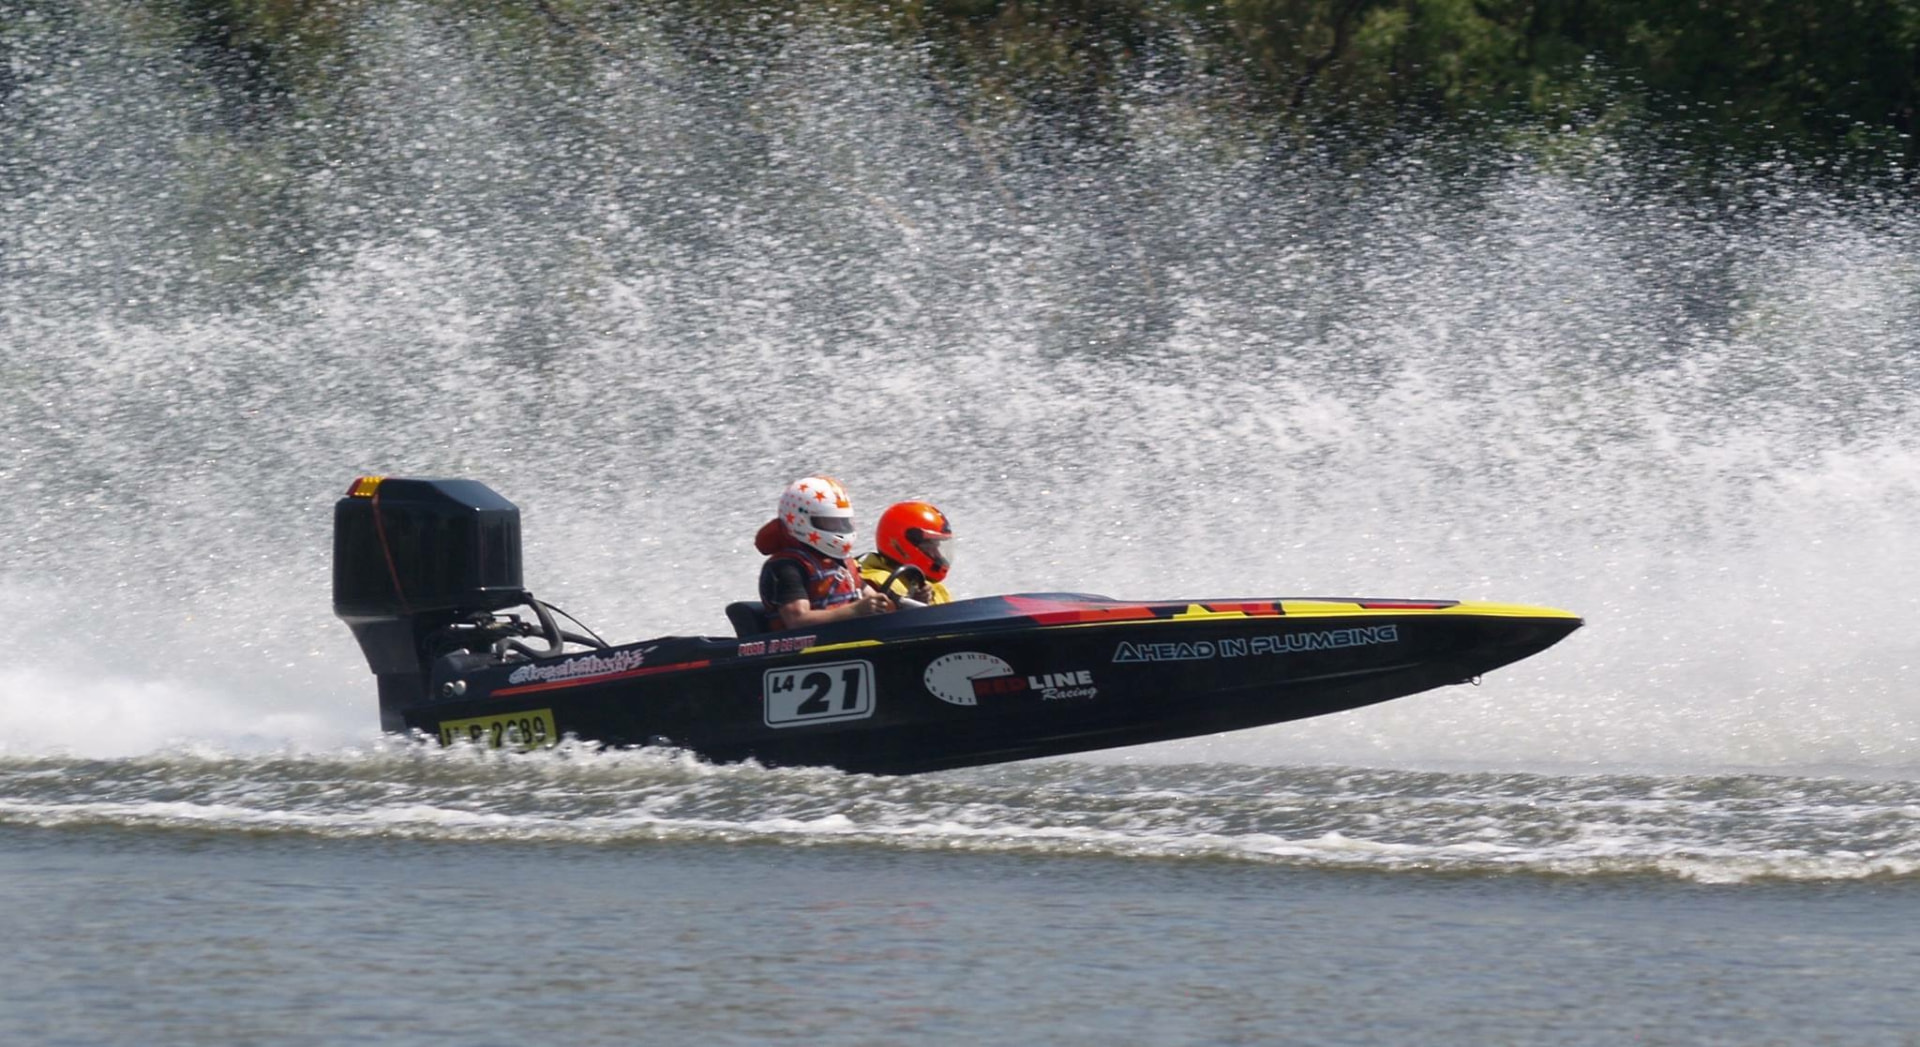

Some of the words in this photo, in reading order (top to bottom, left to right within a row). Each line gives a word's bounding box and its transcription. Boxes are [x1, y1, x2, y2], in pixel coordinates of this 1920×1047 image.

[1112, 641, 1216, 662] AHEAD
[1218, 638, 1249, 657] IN
[1251, 624, 1398, 655] PLUMBING
[772, 675, 794, 694] L4
[796, 668, 860, 715] 21
[1040, 686, 1098, 702] Racing
